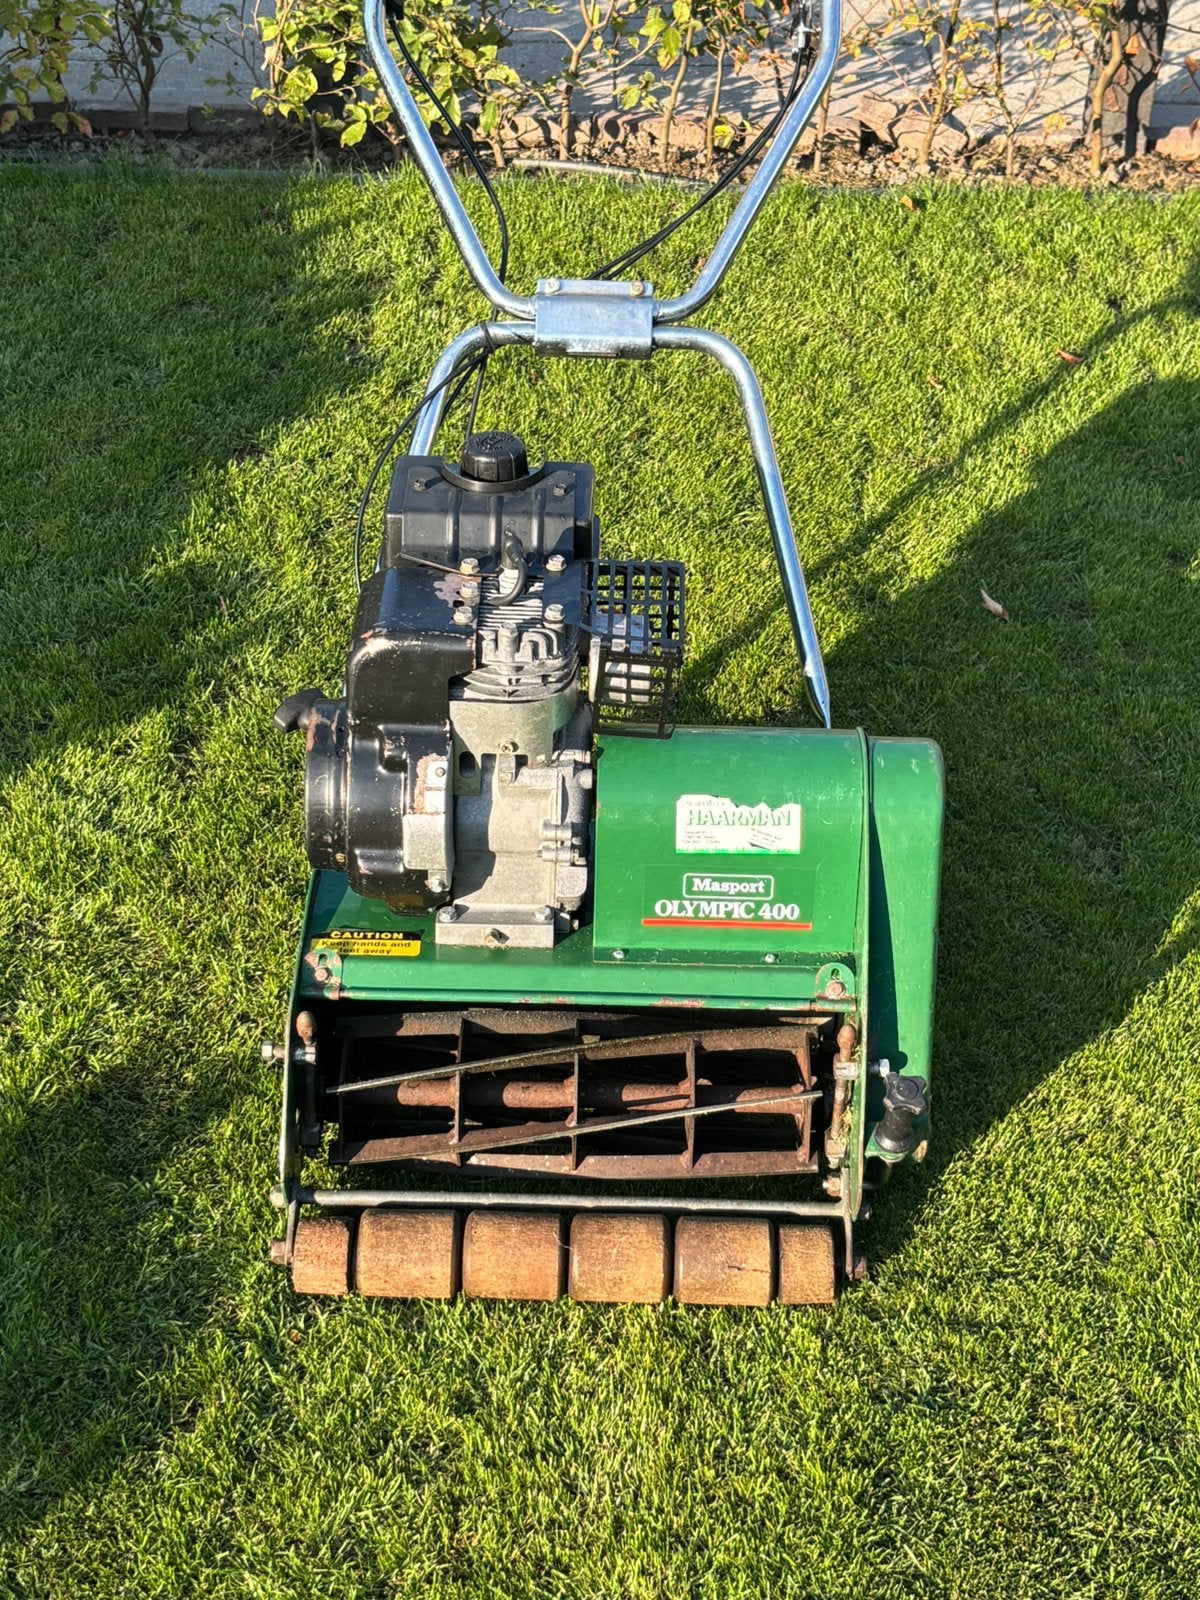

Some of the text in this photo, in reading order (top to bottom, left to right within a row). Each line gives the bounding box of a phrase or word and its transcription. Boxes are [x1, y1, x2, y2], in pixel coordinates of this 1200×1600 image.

[685, 809, 792, 826] HAARMAN
[692, 878, 766, 895] Masport
[654, 899, 800, 920] OLYMPIC 400
[321, 940, 350, 948] Keep
[330, 931, 404, 940] CAUTION
